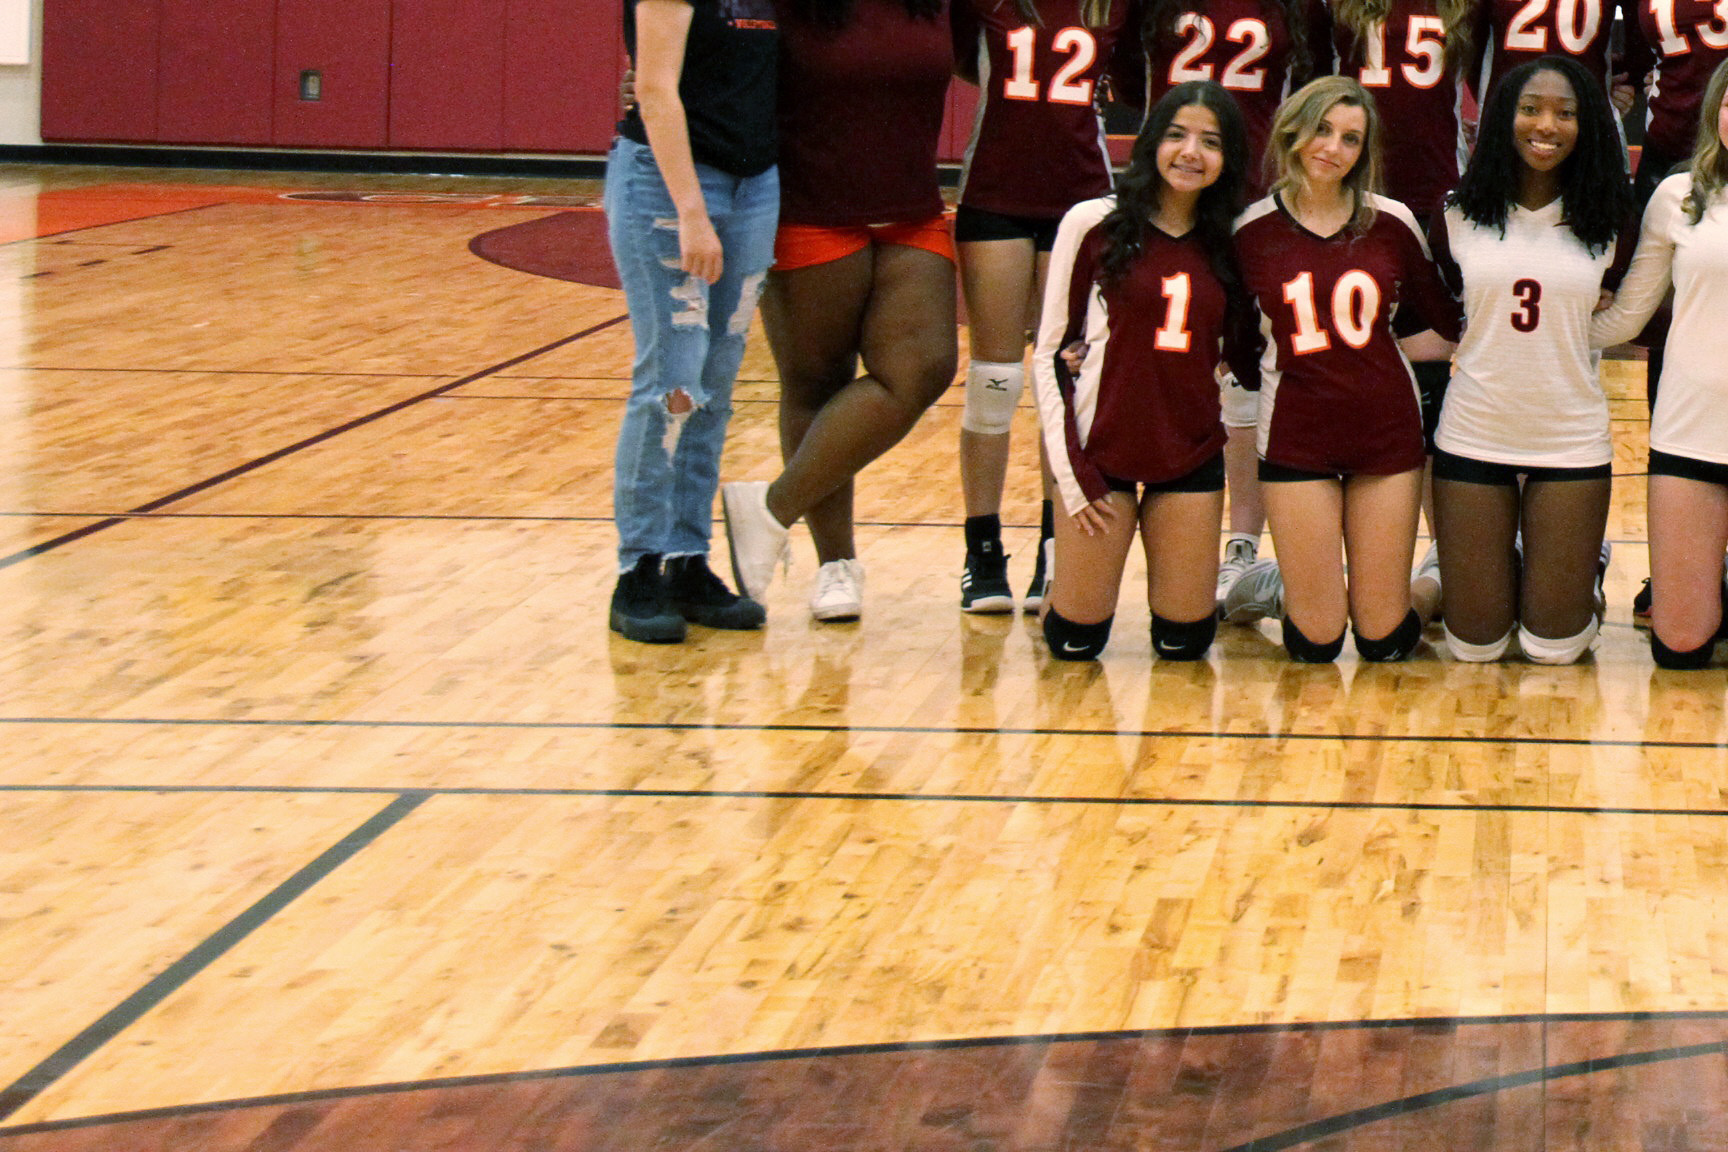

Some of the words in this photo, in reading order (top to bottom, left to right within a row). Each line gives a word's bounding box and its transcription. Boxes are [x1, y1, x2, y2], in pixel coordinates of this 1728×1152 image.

[1004, 25, 1098, 106] 12
[1167, 11, 1273, 91] 22
[1359, 14, 1447, 88] 15
[1154, 271, 1192, 353] 1
[1282, 269, 1381, 356] 10
[1510, 278, 1542, 333] 3
